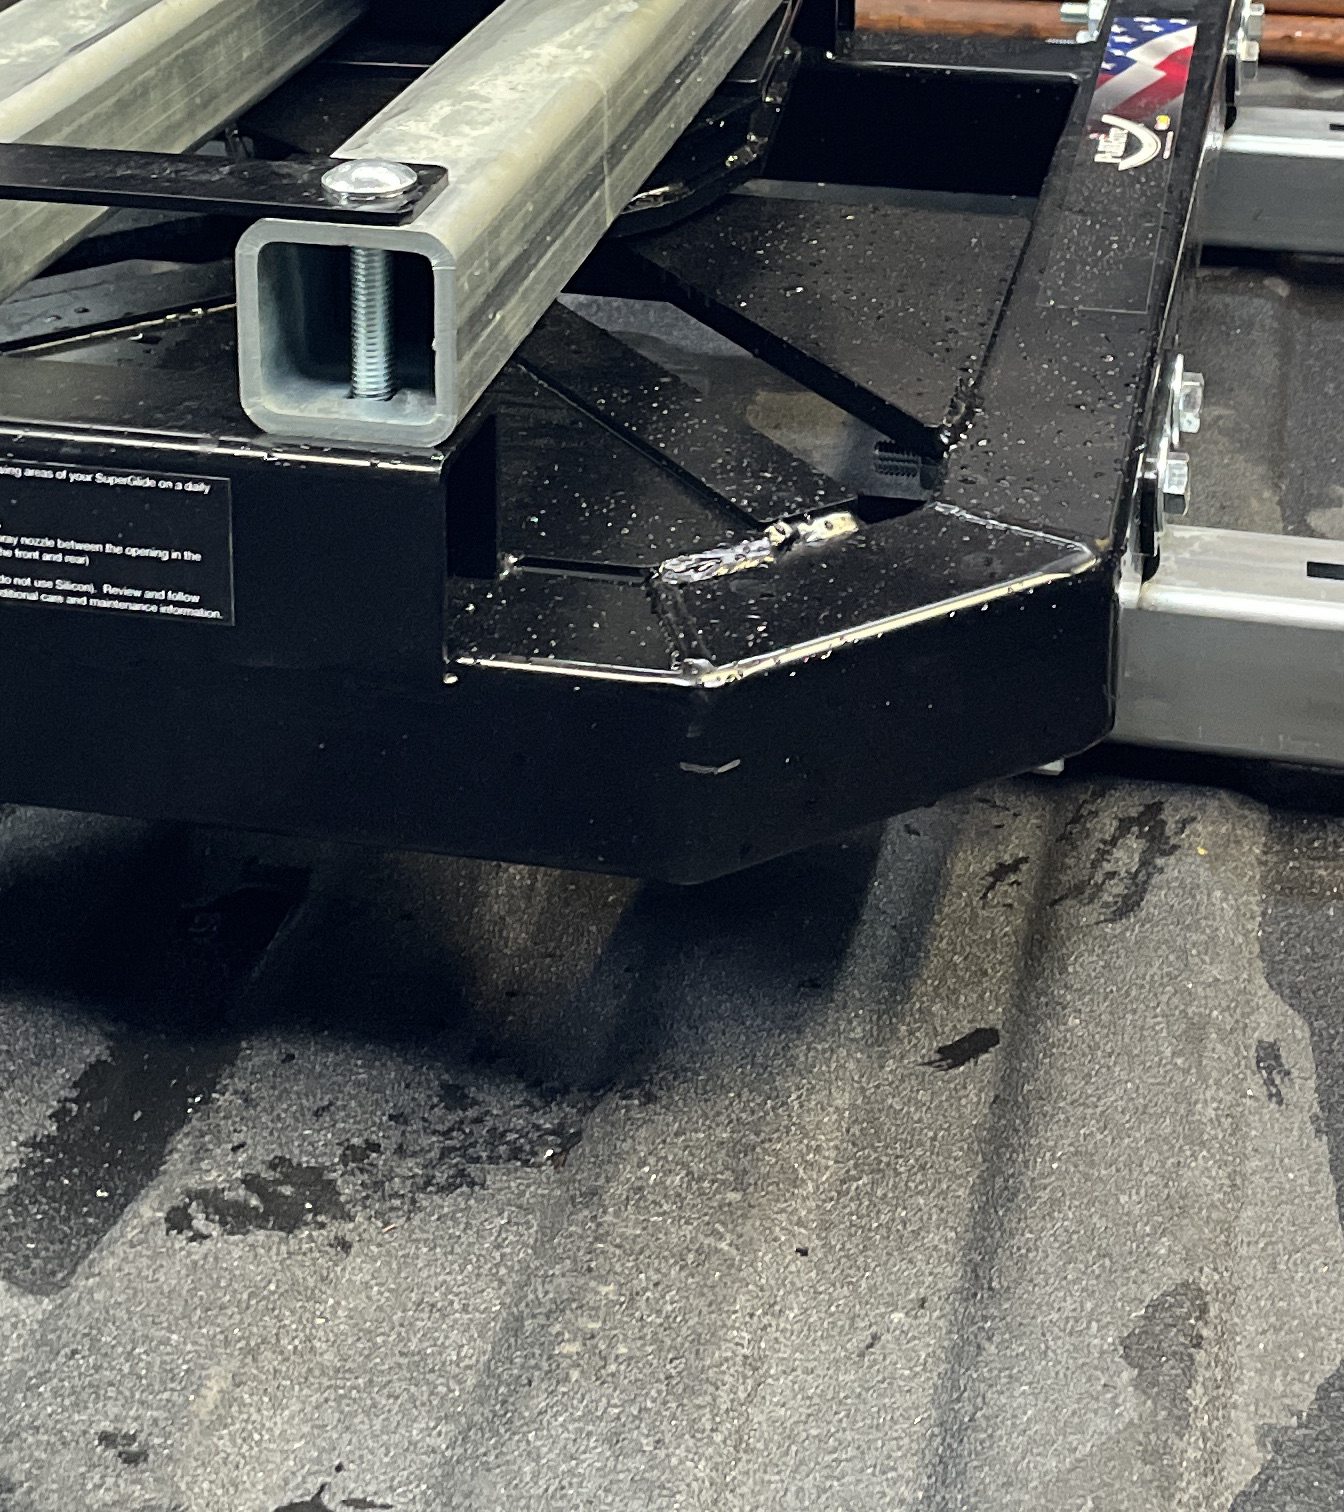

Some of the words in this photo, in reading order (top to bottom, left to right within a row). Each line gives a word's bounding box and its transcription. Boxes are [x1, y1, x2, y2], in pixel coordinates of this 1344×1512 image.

[23, 466, 54, 479] areas
[55, 470, 67, 479] of
[69, 471, 93, 483] your
[95, 472, 156, 488] SuperGlide
[158, 480, 173, 488] on
[174, 482, 182, 490] a
[184, 481, 211, 494] daily
[14, 548, 39, 560] front
[42, 553, 62, 562] and
[64, 554, 89, 567] rear)
[20, 536, 55, 548] nozzle
[57, 538, 103, 552] between
[105, 543, 123, 554] the
[125, 546, 169, 562] opening
[171, 550, 181, 560] in
[184, 551, 201, 562] the
[13, 576, 31, 587] not
[34, 579, 53, 589] use
[102, 583, 142, 598] Review
[144, 590, 165, 600] and
[167, 590, 200, 603] follow
[40, 594, 64, 603] care
[66, 596, 87, 606] and
[89, 598, 158, 612] maintenance
[159, 605, 223, 620] information.
